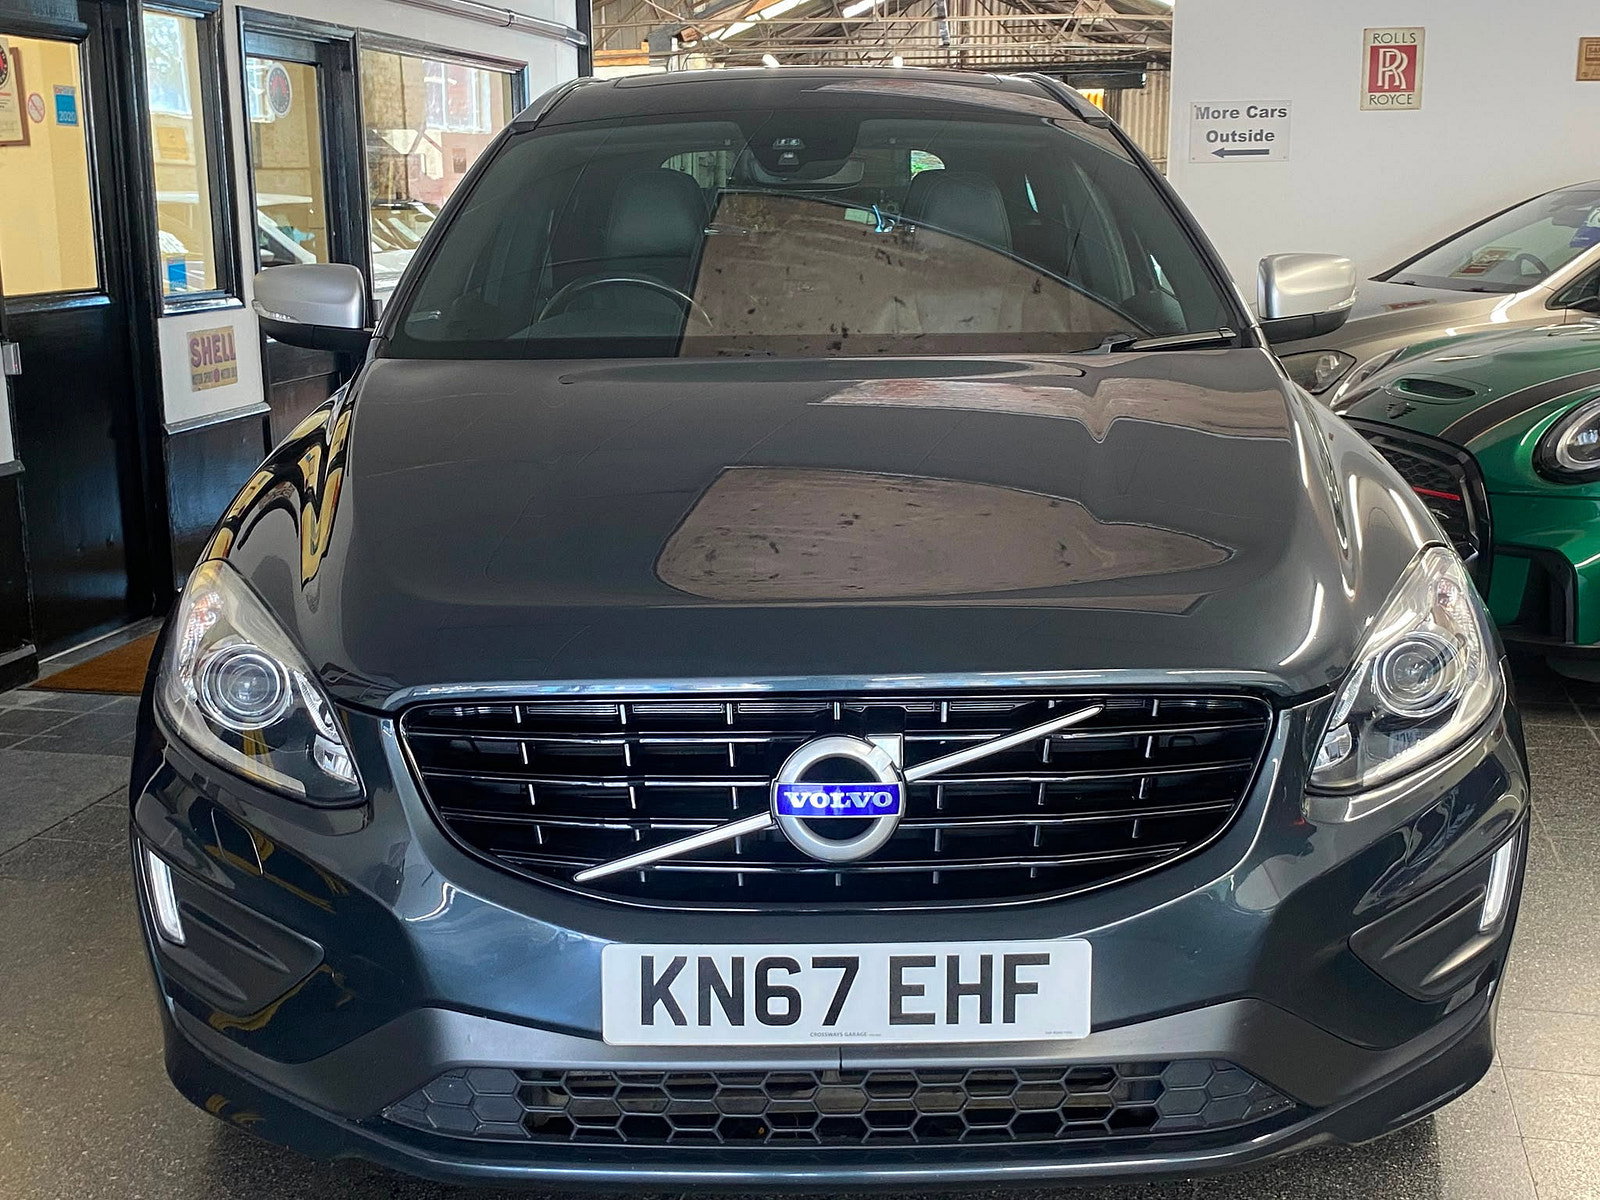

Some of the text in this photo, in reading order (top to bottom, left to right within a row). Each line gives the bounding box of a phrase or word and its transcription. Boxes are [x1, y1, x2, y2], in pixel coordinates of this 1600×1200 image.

[1372, 32, 1416, 44] ROLLS
[1369, 94, 1413, 105] ROYCE
[58, 111, 76, 121] 2020
[1195, 105, 1288, 120] More Cars
[1205, 129, 1275, 143] Outside
[190, 333, 236, 368] SHELL
[783, 791, 893, 808] VOLVO
[640, 953, 1050, 1026] KN67 EHF
